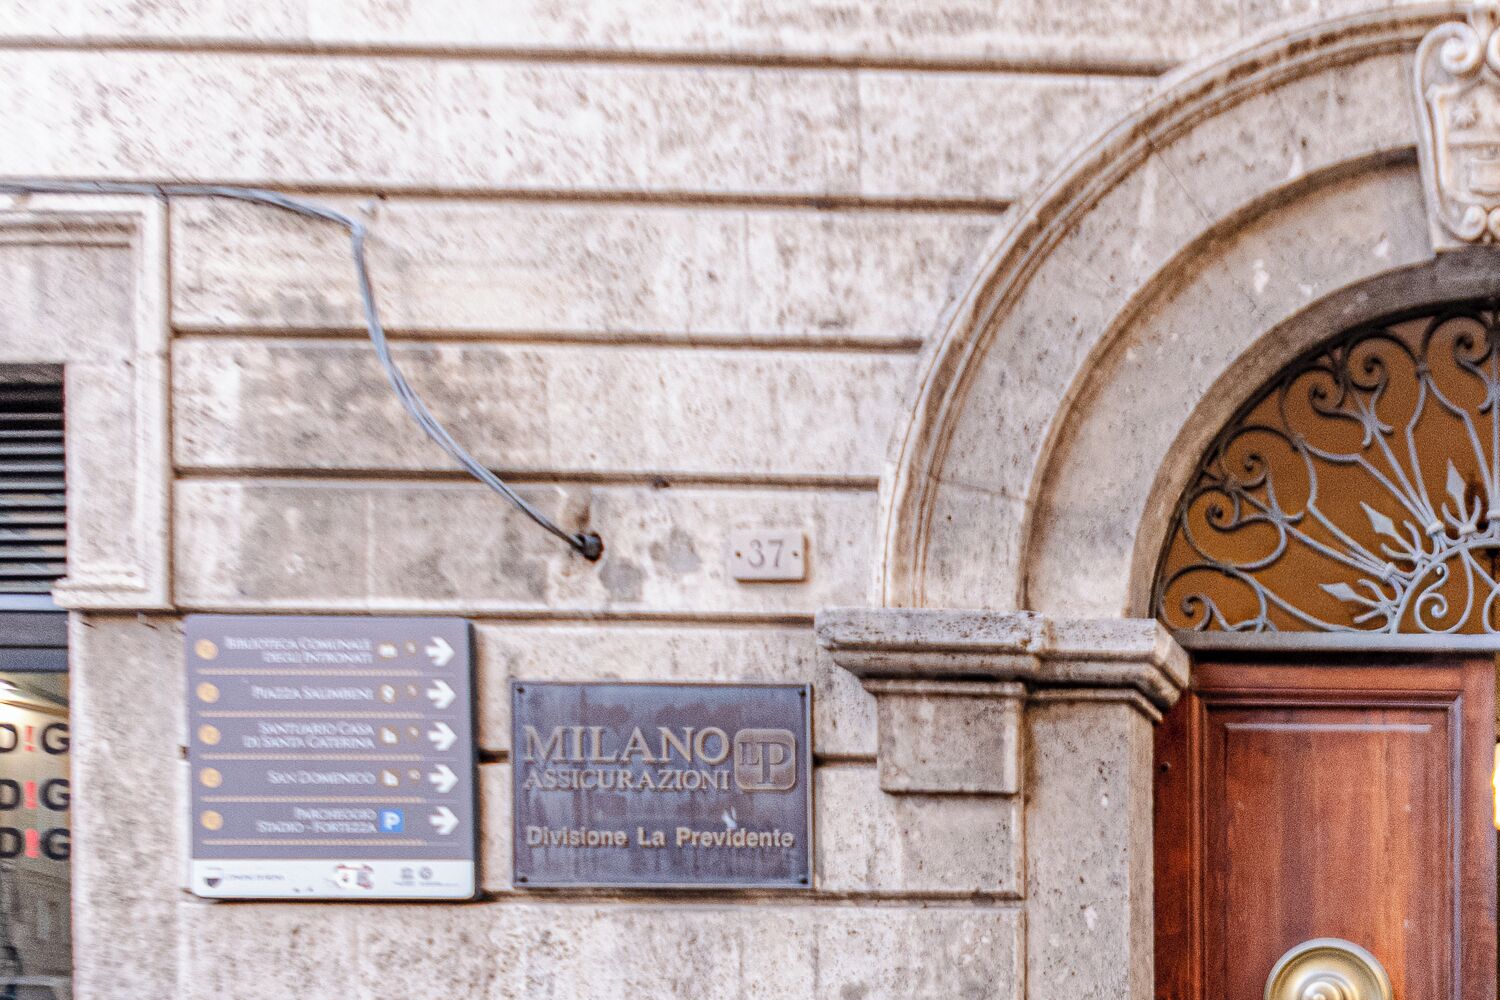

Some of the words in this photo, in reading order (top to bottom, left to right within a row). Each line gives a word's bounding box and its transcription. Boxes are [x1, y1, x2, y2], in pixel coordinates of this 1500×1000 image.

[748, 539, 784, 568] 37
[252, 686, 302, 699] PIAZZA
[258, 721, 337, 735] SANTUARIO
[337, 721, 375, 735] CASA
[261, 735, 305, 748] SANTA
[305, 735, 375, 749] CATERINA
[523, 725, 730, 765] MILANO
[267, 770, 297, 784] SAN
[297, 770, 376, 784] DOMENICO
[522, 769, 730, 791] ASSICURAZIONI
[383, 811, 400, 830] P
[526, 825, 627, 847] Divisione
[637, 826, 664, 847] La
[676, 826, 794, 848] Previdente
